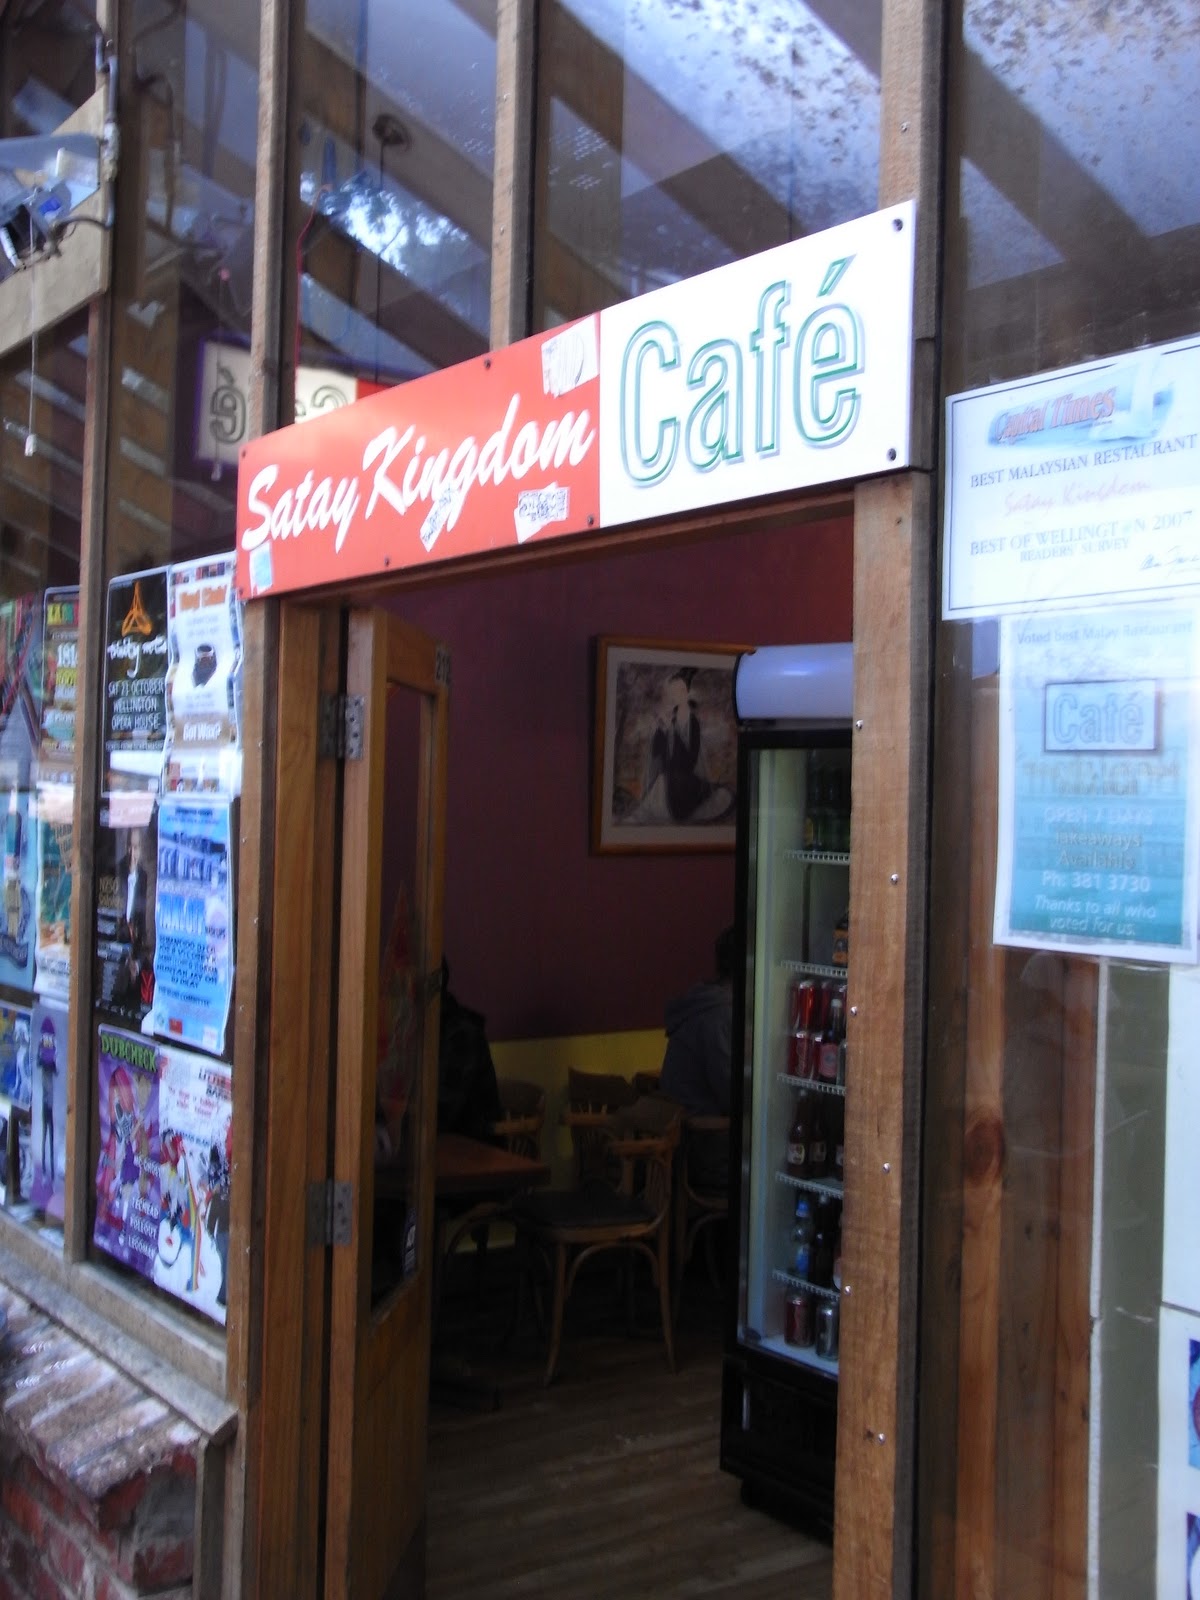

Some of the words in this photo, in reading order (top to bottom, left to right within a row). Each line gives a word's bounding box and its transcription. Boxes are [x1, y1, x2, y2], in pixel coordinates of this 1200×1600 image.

[242, 464, 359, 553] Satay
[362, 392, 597, 532] Kingdom
[620, 254, 867, 490] Café
[995, 400, 1045, 446] Capital
[1051, 386, 1118, 430] Times
[970, 469, 1004, 489] BEST
[1008, 454, 1088, 481] MALAYSIAN
[1093, 433, 1198, 467] RESTAURANT
[970, 537, 1006, 556] BEST
[1010, 532, 1032, 550] OF
[1017, 630, 1050, 645] Voted
[1054, 627, 1079, 642] best
[108, 680, 120, 697] SAT
[131, 677, 165, 696] OCTOBER
[113, 695, 158, 712] WELLINGTON
[111, 713, 132, 730] OPERA
[134, 712, 161, 730] HOUSE
[1052, 690, 1145, 745] Café
[1044, 807, 1088, 824] OPEN
[1056, 831, 1142, 851] Takeaways
[1071, 871, 1100, 890] 381
[1108, 875, 1151, 893] 3730
[1035, 893, 1081, 913] Thanks
[1085, 899, 1100, 914] to
[1103, 900, 1121, 917] all
[1125, 902, 1157, 920] who
[1051, 915, 1089, 932] voted
[1093, 915, 1114, 934] for
